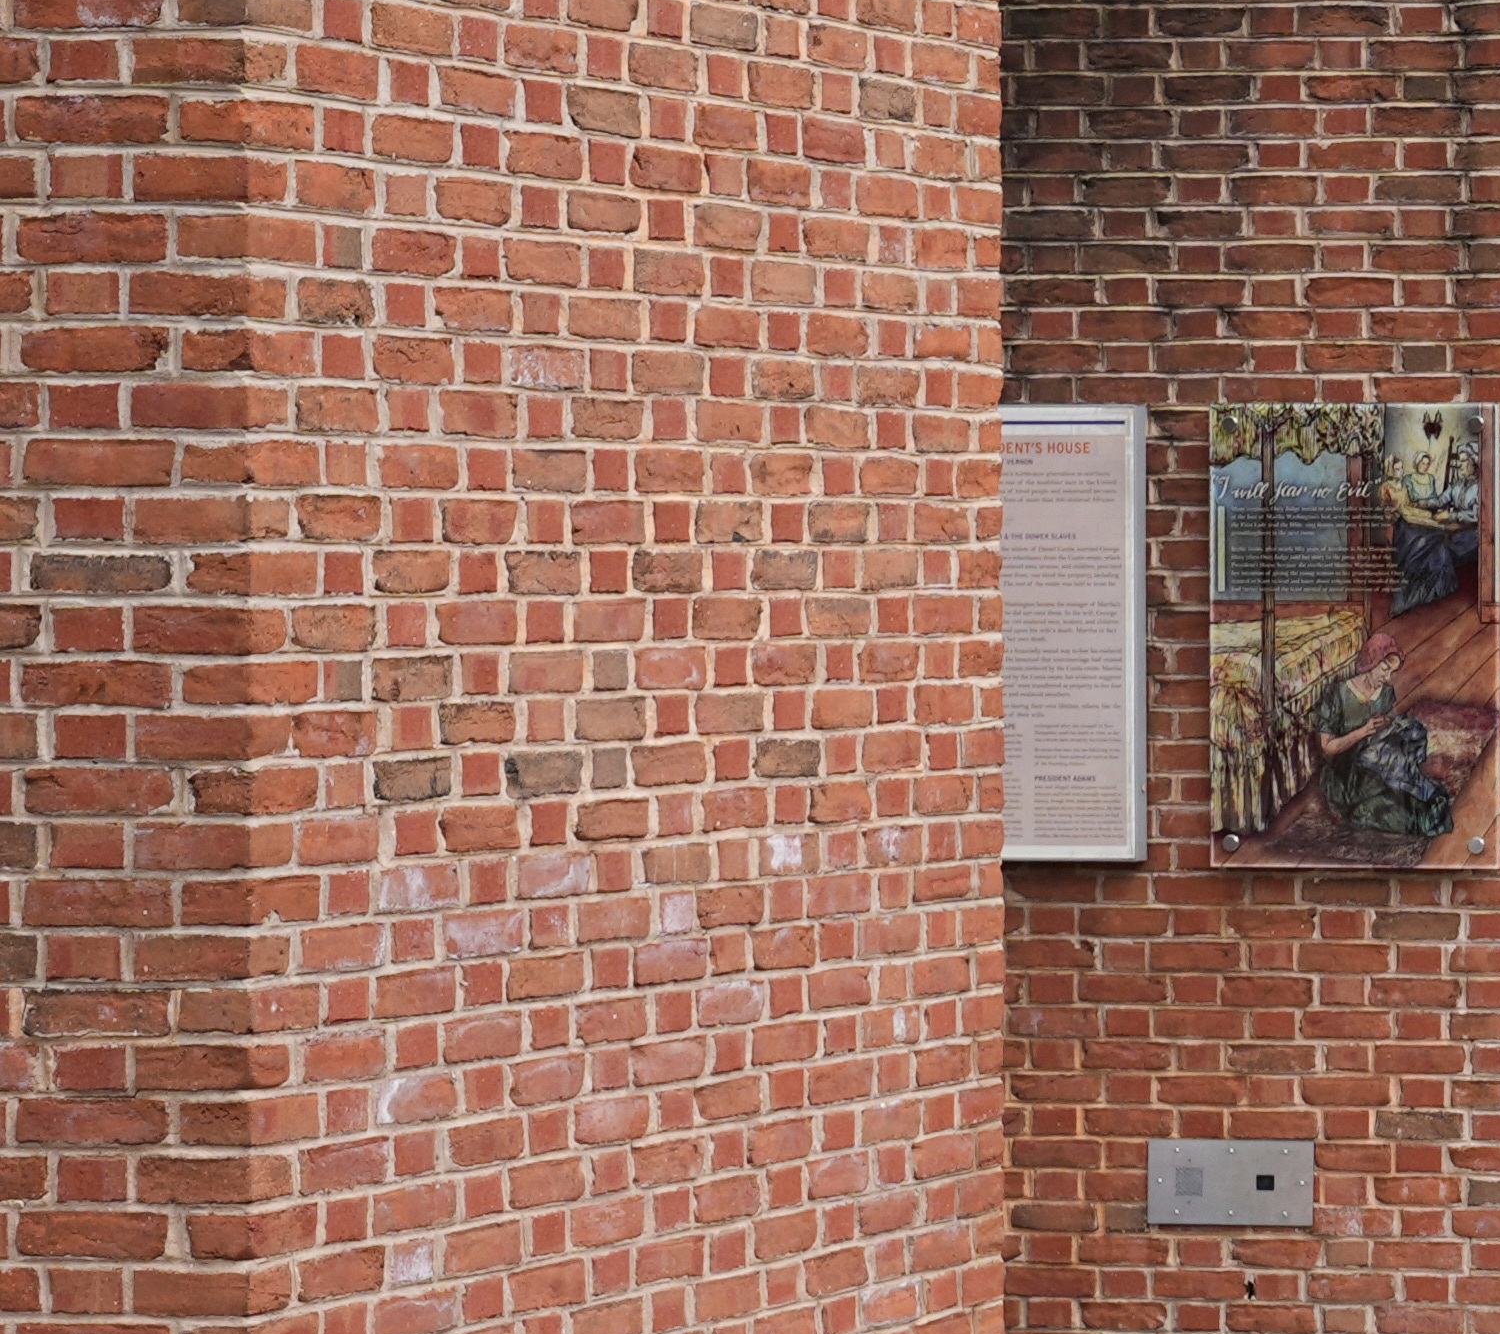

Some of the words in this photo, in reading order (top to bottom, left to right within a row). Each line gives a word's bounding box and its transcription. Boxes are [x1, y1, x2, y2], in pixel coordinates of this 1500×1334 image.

[1047, 442, 1091, 454] HOUSE
[1231, 482, 1269, 500] will
[1269, 481, 1307, 505] fear
[1311, 487, 1333, 498] no
